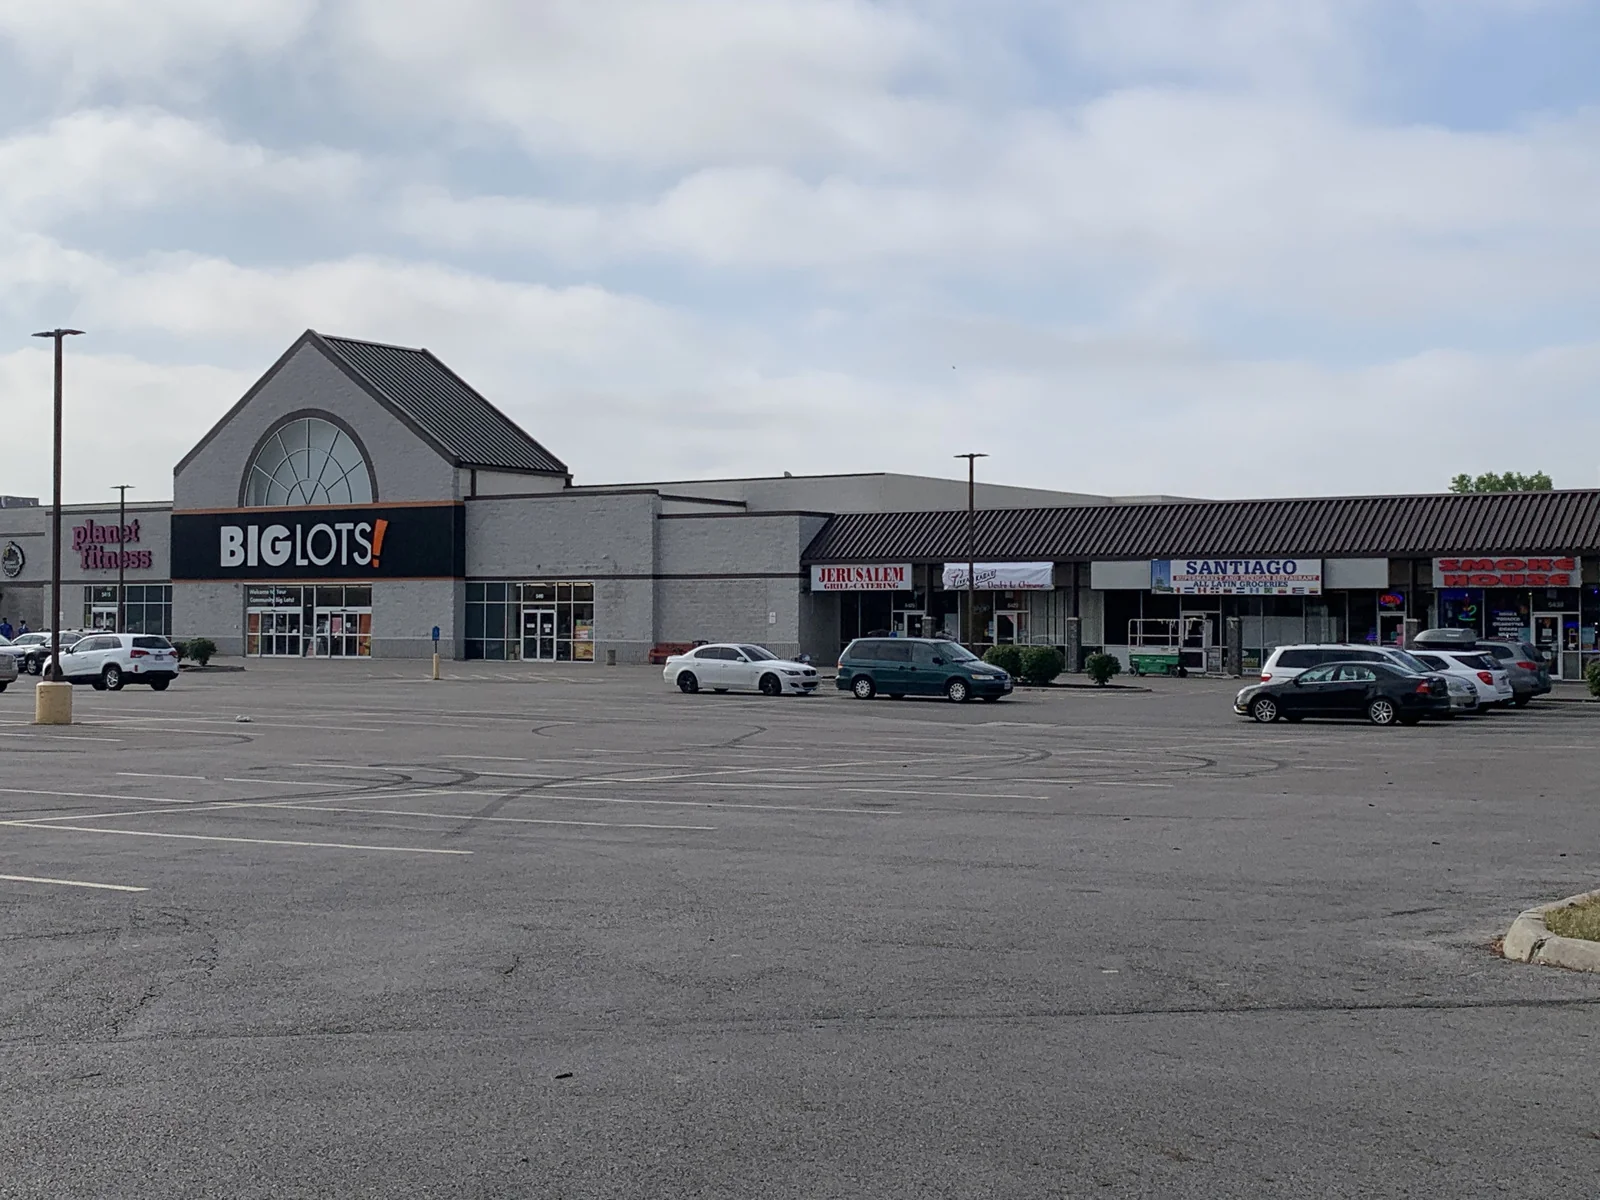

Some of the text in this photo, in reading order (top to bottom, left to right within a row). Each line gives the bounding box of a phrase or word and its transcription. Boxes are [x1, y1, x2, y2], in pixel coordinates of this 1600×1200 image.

[72, 519, 140, 551] planet
[80, 545, 153, 569] fitness
[1439, 558, 1576, 571] SMOKE
[818, 567, 905, 583] JERUSALEM
[1186, 560, 1298, 575] SANTIAGO
[1444, 573, 1570, 586] HOUSE
